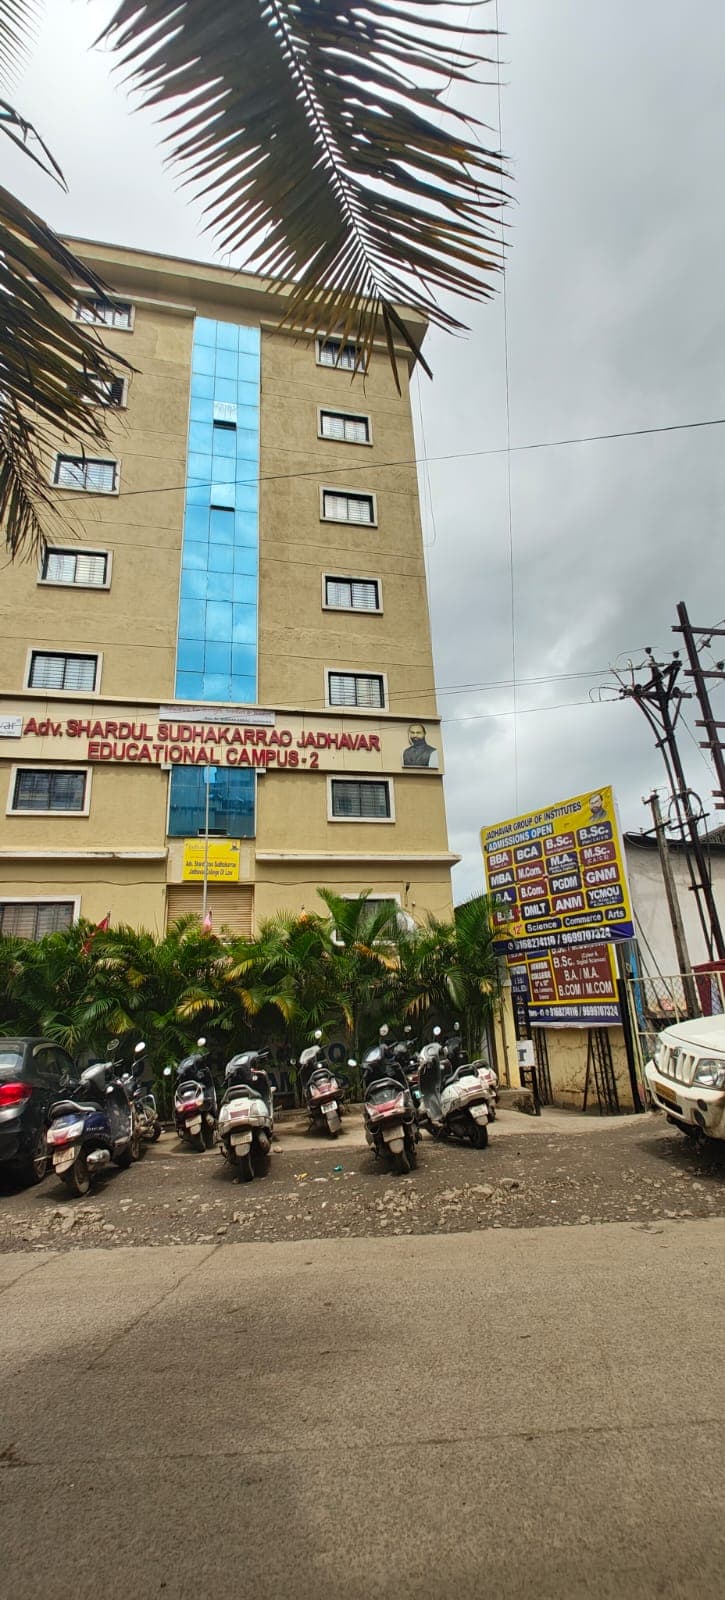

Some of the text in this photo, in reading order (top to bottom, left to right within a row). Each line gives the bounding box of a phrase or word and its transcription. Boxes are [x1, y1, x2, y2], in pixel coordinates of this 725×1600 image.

[23, 717, 380, 752] Adv. SHARDUL SUDHAKARRAO JADHAVAR
[88, 741, 220, 765] EDUCATIONAL
[513, 818, 532, 832] GROUP
[534, 814, 543, 824] OF
[543, 801, 582, 821] INSTITUTES
[488, 830, 530, 851] ADMISSIONS
[530, 825, 553, 839] OPEN
[579, 825, 609, 840] B.Sc.
[546, 835, 573, 849] B.Sc.
[489, 853, 509, 866] BBA
[516, 845, 539, 861] BCA
[584, 846, 611, 860] M.Sc.
[550, 855, 572, 867] M.A.
[490, 871, 512, 886] MBA
[518, 865, 542, 879] M.Com.
[586, 867, 616, 883] GNM
[552, 875, 578, 891] PGDM
[521, 885, 544, 898] B.Com.
[588, 886, 620, 901] YCMOU
[524, 903, 546, 917] DMLT
[555, 896, 583, 912] ANM
[565, 913, 601, 927] Commerce
[608, 909, 624, 920] Arts
[527, 920, 557, 932] Science
[553, 955, 575, 968] B.Sc.
[582, 966, 599, 979] M.A.
[558, 984, 581, 996] B.COM
[586, 981, 613, 994] M.COM
